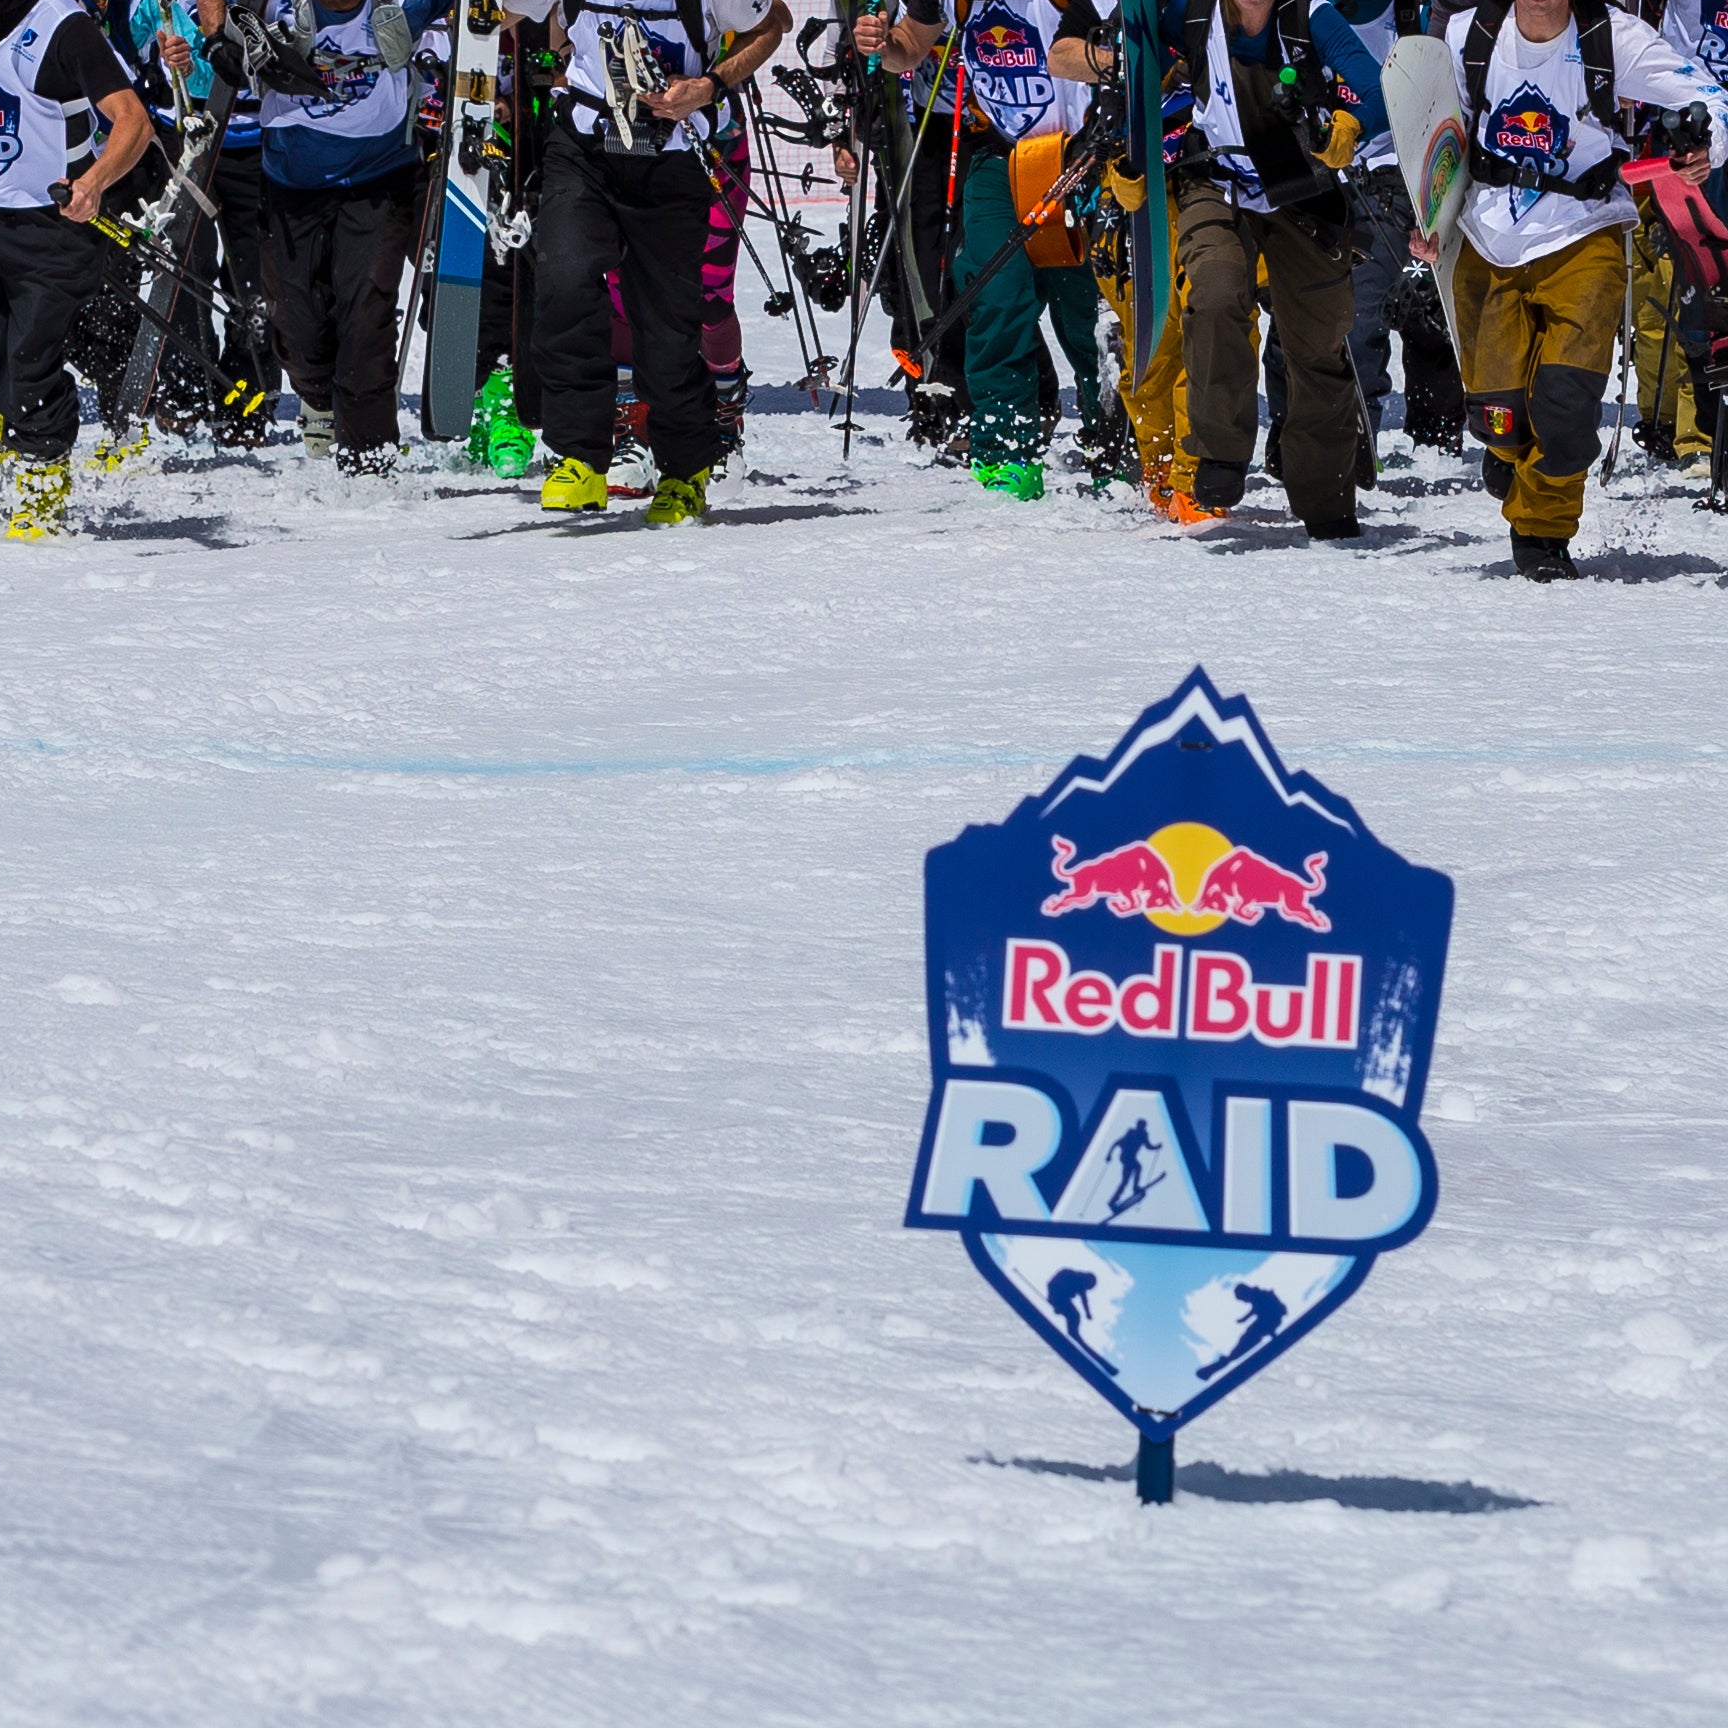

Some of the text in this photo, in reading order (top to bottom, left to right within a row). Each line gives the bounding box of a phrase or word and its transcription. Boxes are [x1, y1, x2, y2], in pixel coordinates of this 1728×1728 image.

[1004, 48, 1036, 67] Bull
[973, 71, 1054, 105] RAID
[1497, 131, 1535, 148] Red
[1003, 938, 1363, 1049] Red Bull
[920, 1080, 1423, 1241] RAID
